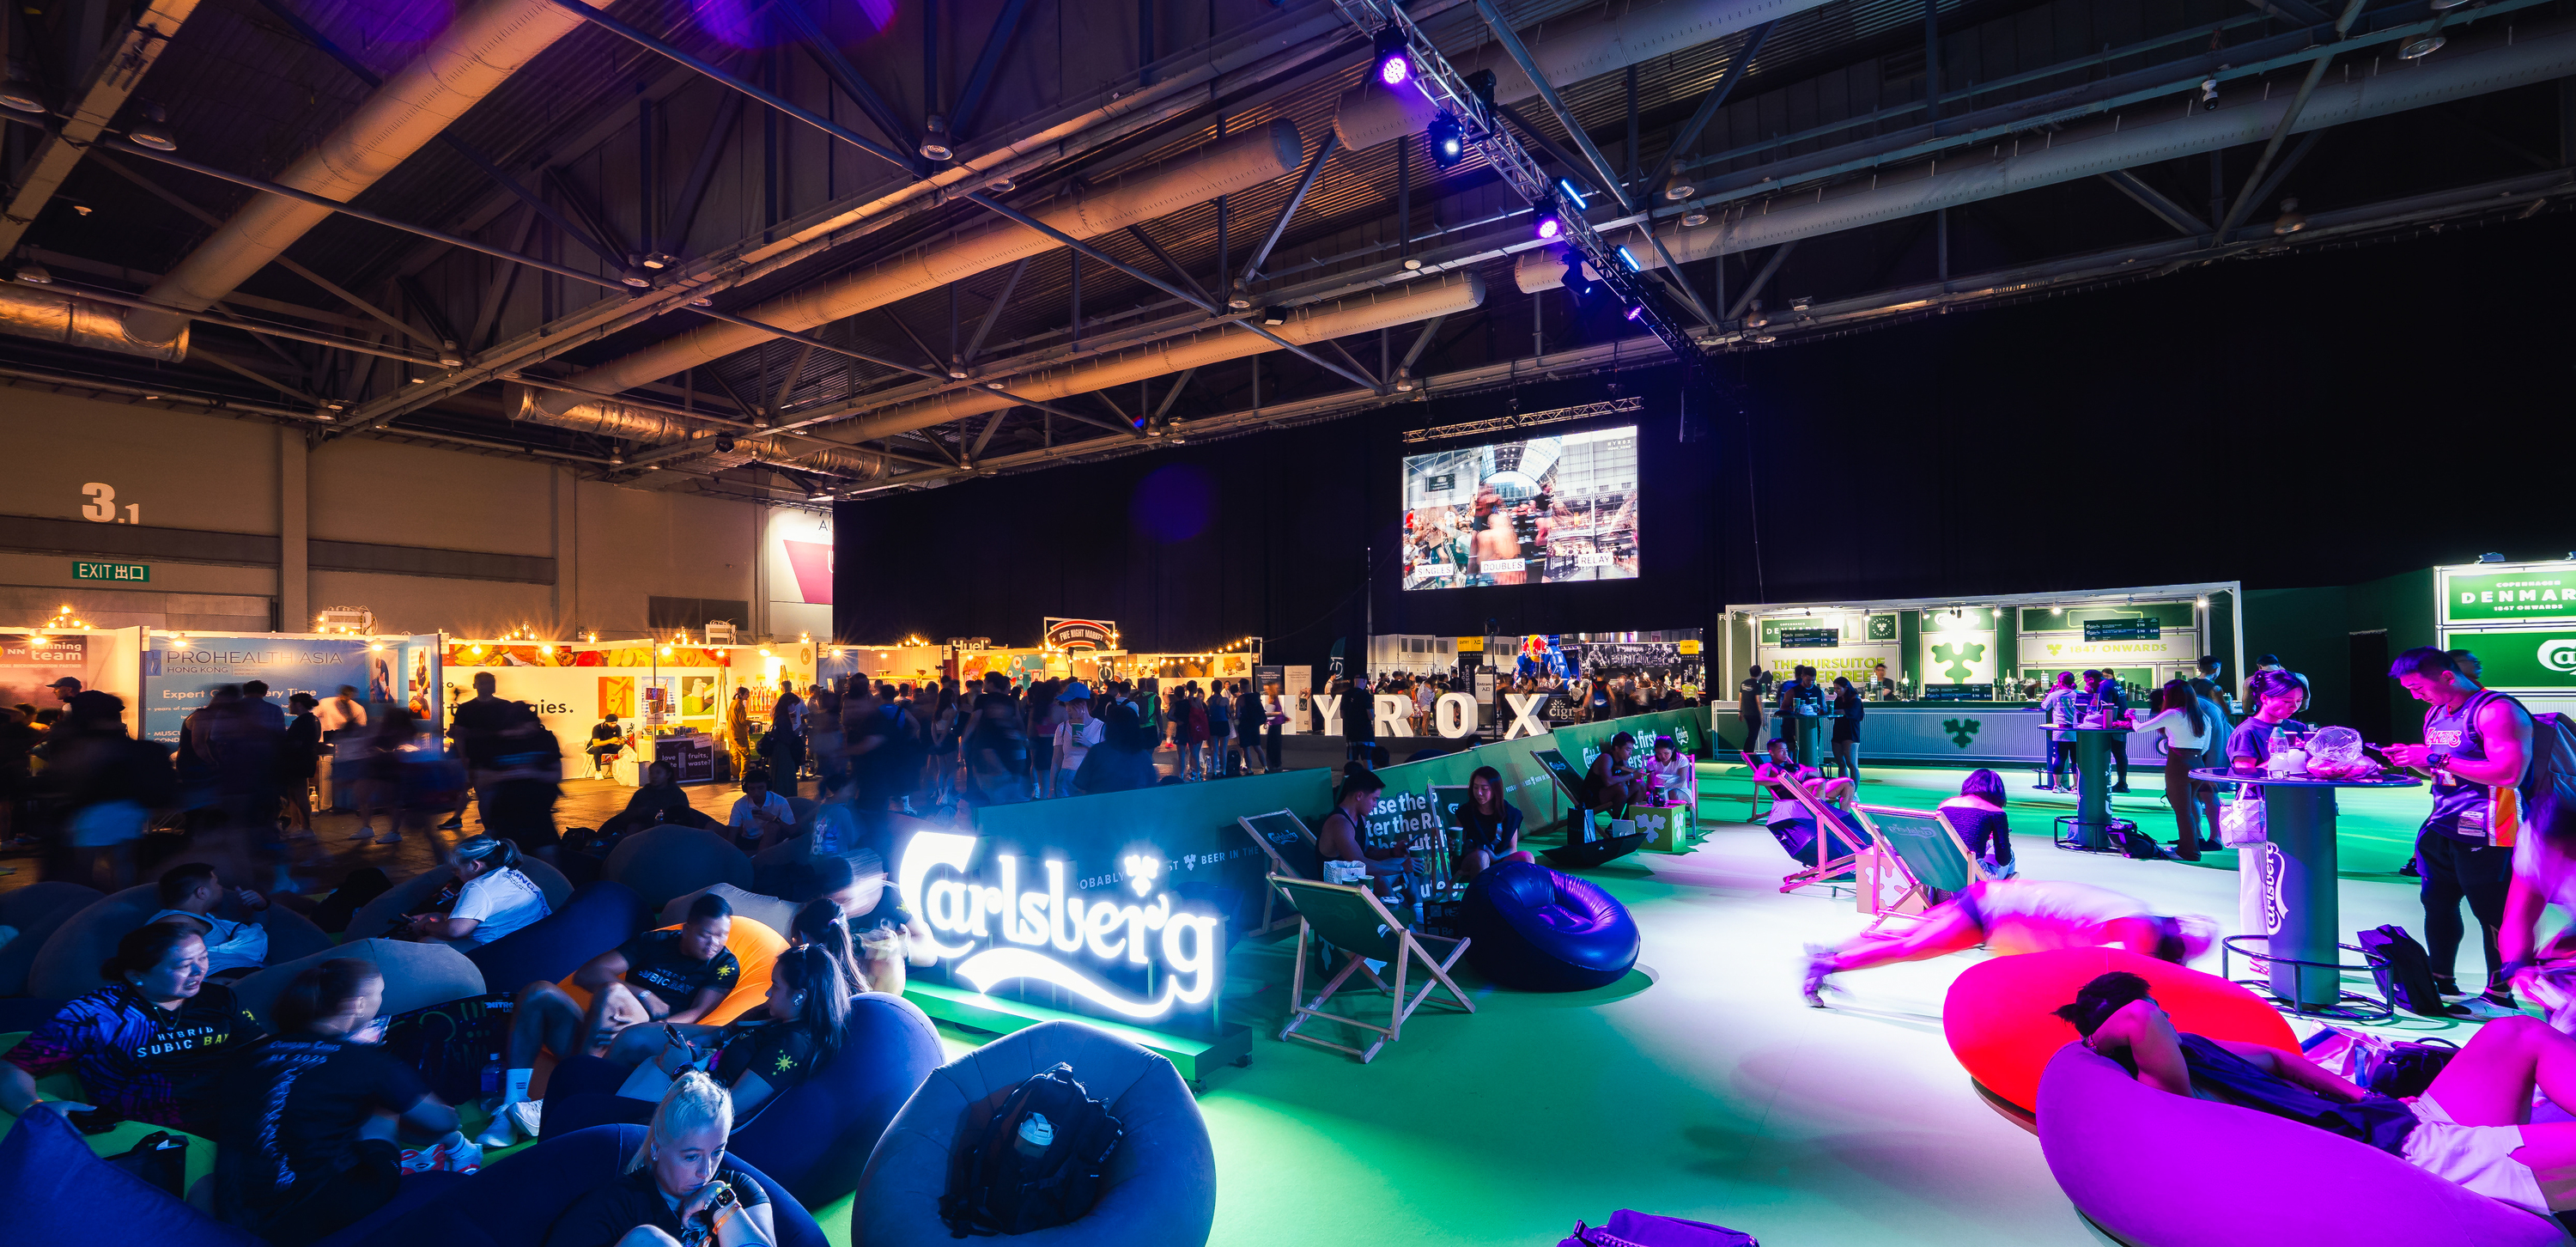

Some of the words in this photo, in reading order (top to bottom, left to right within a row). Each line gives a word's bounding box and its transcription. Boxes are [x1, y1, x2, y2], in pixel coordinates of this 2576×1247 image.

[82, 482, 139, 524] 3.1
[1483, 561, 1522, 571] DOUBLES
[1581, 556, 1610, 564] RELAY
[79, 563, 112, 579] EXIT
[115, 565, 143, 580] 出口
[1418, 566, 1451, 575] SINGLES
[1084, 630, 1103, 641] MARKET
[32, 642, 82, 651] nning
[952, 640, 984, 651] Huel
[2069, 644, 2097, 654] 1847
[2102, 643, 2167, 653] ONWARDS
[32, 650, 82, 660] team
[167, 651, 293, 664] PROHEALTH
[300, 652, 343, 664] ASIA
[1772, 659, 1797, 670] THE
[1801, 658, 1864, 669] PURSUIT
[1864, 657, 1885, 668] OF
[1772, 671, 1837, 683] BEER
[163, 690, 205, 700] Expert
[266, 690, 283, 699] ery
[288, 688, 317, 696] Time
[1637, 730, 1657, 748] first
[2426, 727, 2462, 748] LAKERS
[1627, 755, 1643, 768] ers
[1399, 793, 1426, 812] the
[1365, 820, 1390, 837] ter
[1393, 814, 1419, 834] the
[1267, 831, 1298, 844] Carlsberg
[1077, 872, 1125, 891] OBABLY
[1201, 852, 1225, 865] BEER
[1230, 849, 1239, 860] IN
[1242, 846, 1259, 857] THE
[899, 830, 1218, 1005] Carlsberg
[667, 980, 695, 995] BAY
[158, 1026, 214, 1041] HYBRID
[137, 1039, 192, 1058] SUBIC
[204, 1033, 229, 1046] BAY
